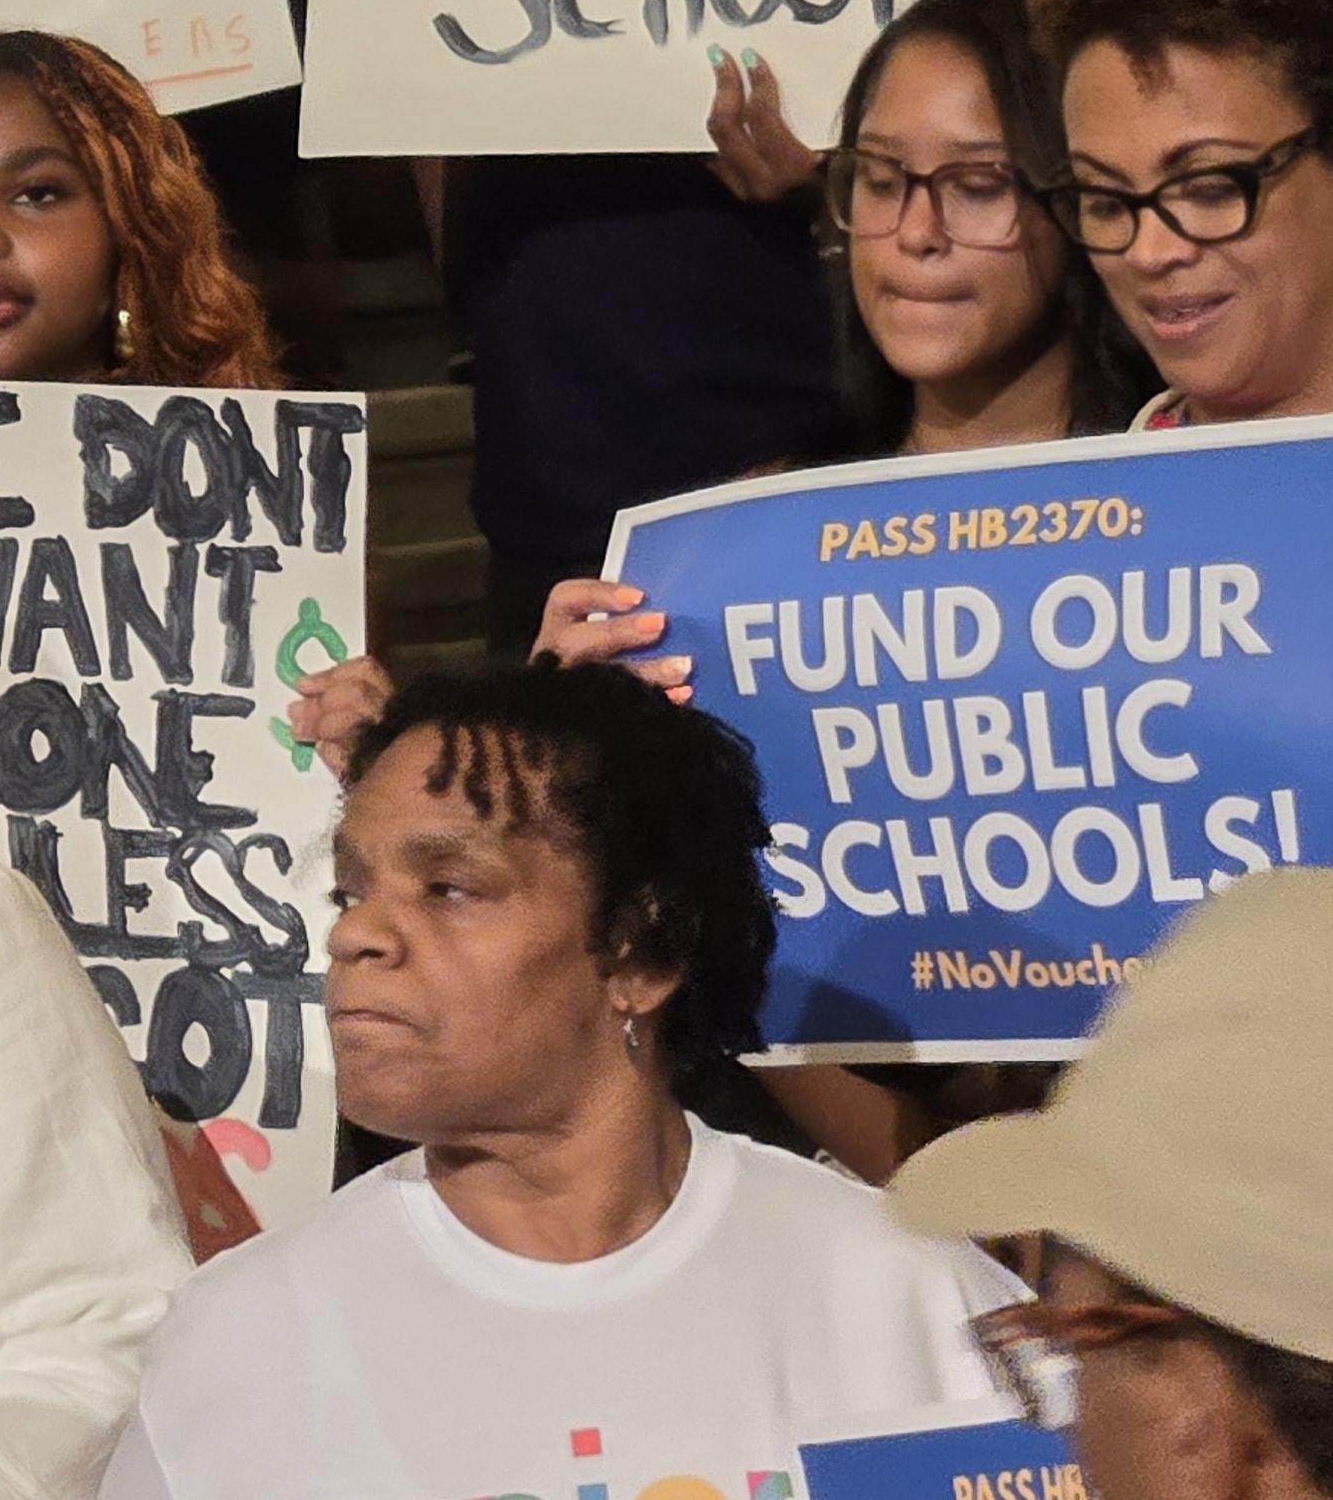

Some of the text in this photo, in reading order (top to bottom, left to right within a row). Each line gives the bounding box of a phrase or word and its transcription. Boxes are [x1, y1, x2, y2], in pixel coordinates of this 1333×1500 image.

[72, 392, 370, 556] DONT
[818, 497, 1145, 563] PASS HB2370:
[723, 562, 1273, 696] FUND OUR
[811, 678, 1201, 805] PUBLIC
